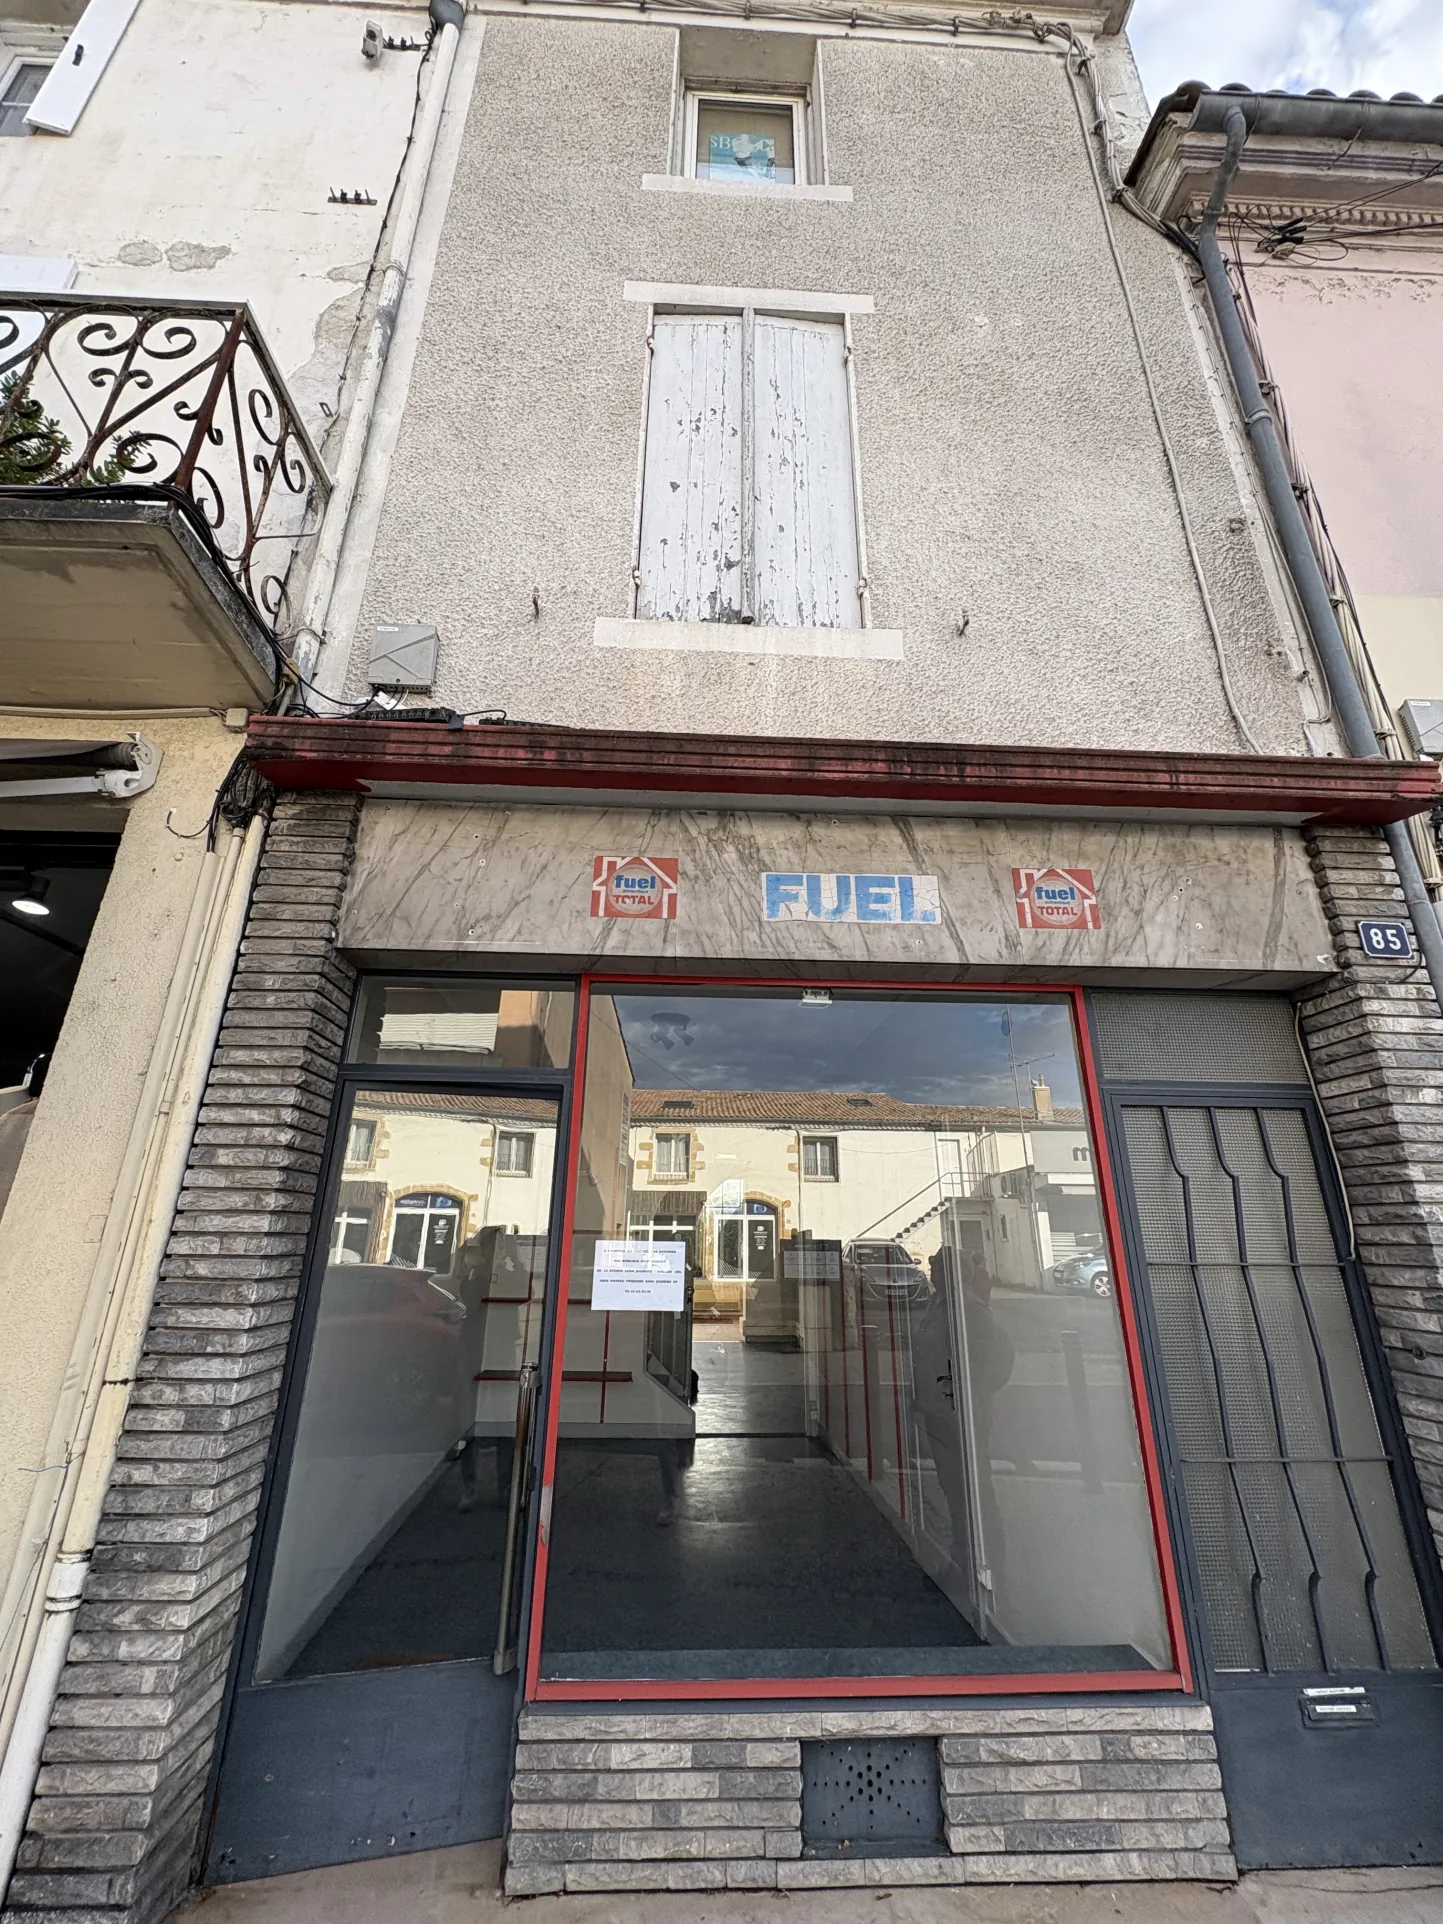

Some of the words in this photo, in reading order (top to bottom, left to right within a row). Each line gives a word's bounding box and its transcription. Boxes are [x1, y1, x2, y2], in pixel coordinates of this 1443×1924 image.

[615, 875, 656, 889] fuel
[613, 895, 654, 905] TOTAL
[765, 873, 937, 922] FUEL
[1035, 887, 1076, 900] fuel
[1037, 905, 1078, 916] TOTAL
[1369, 928, 1402, 950] 85
